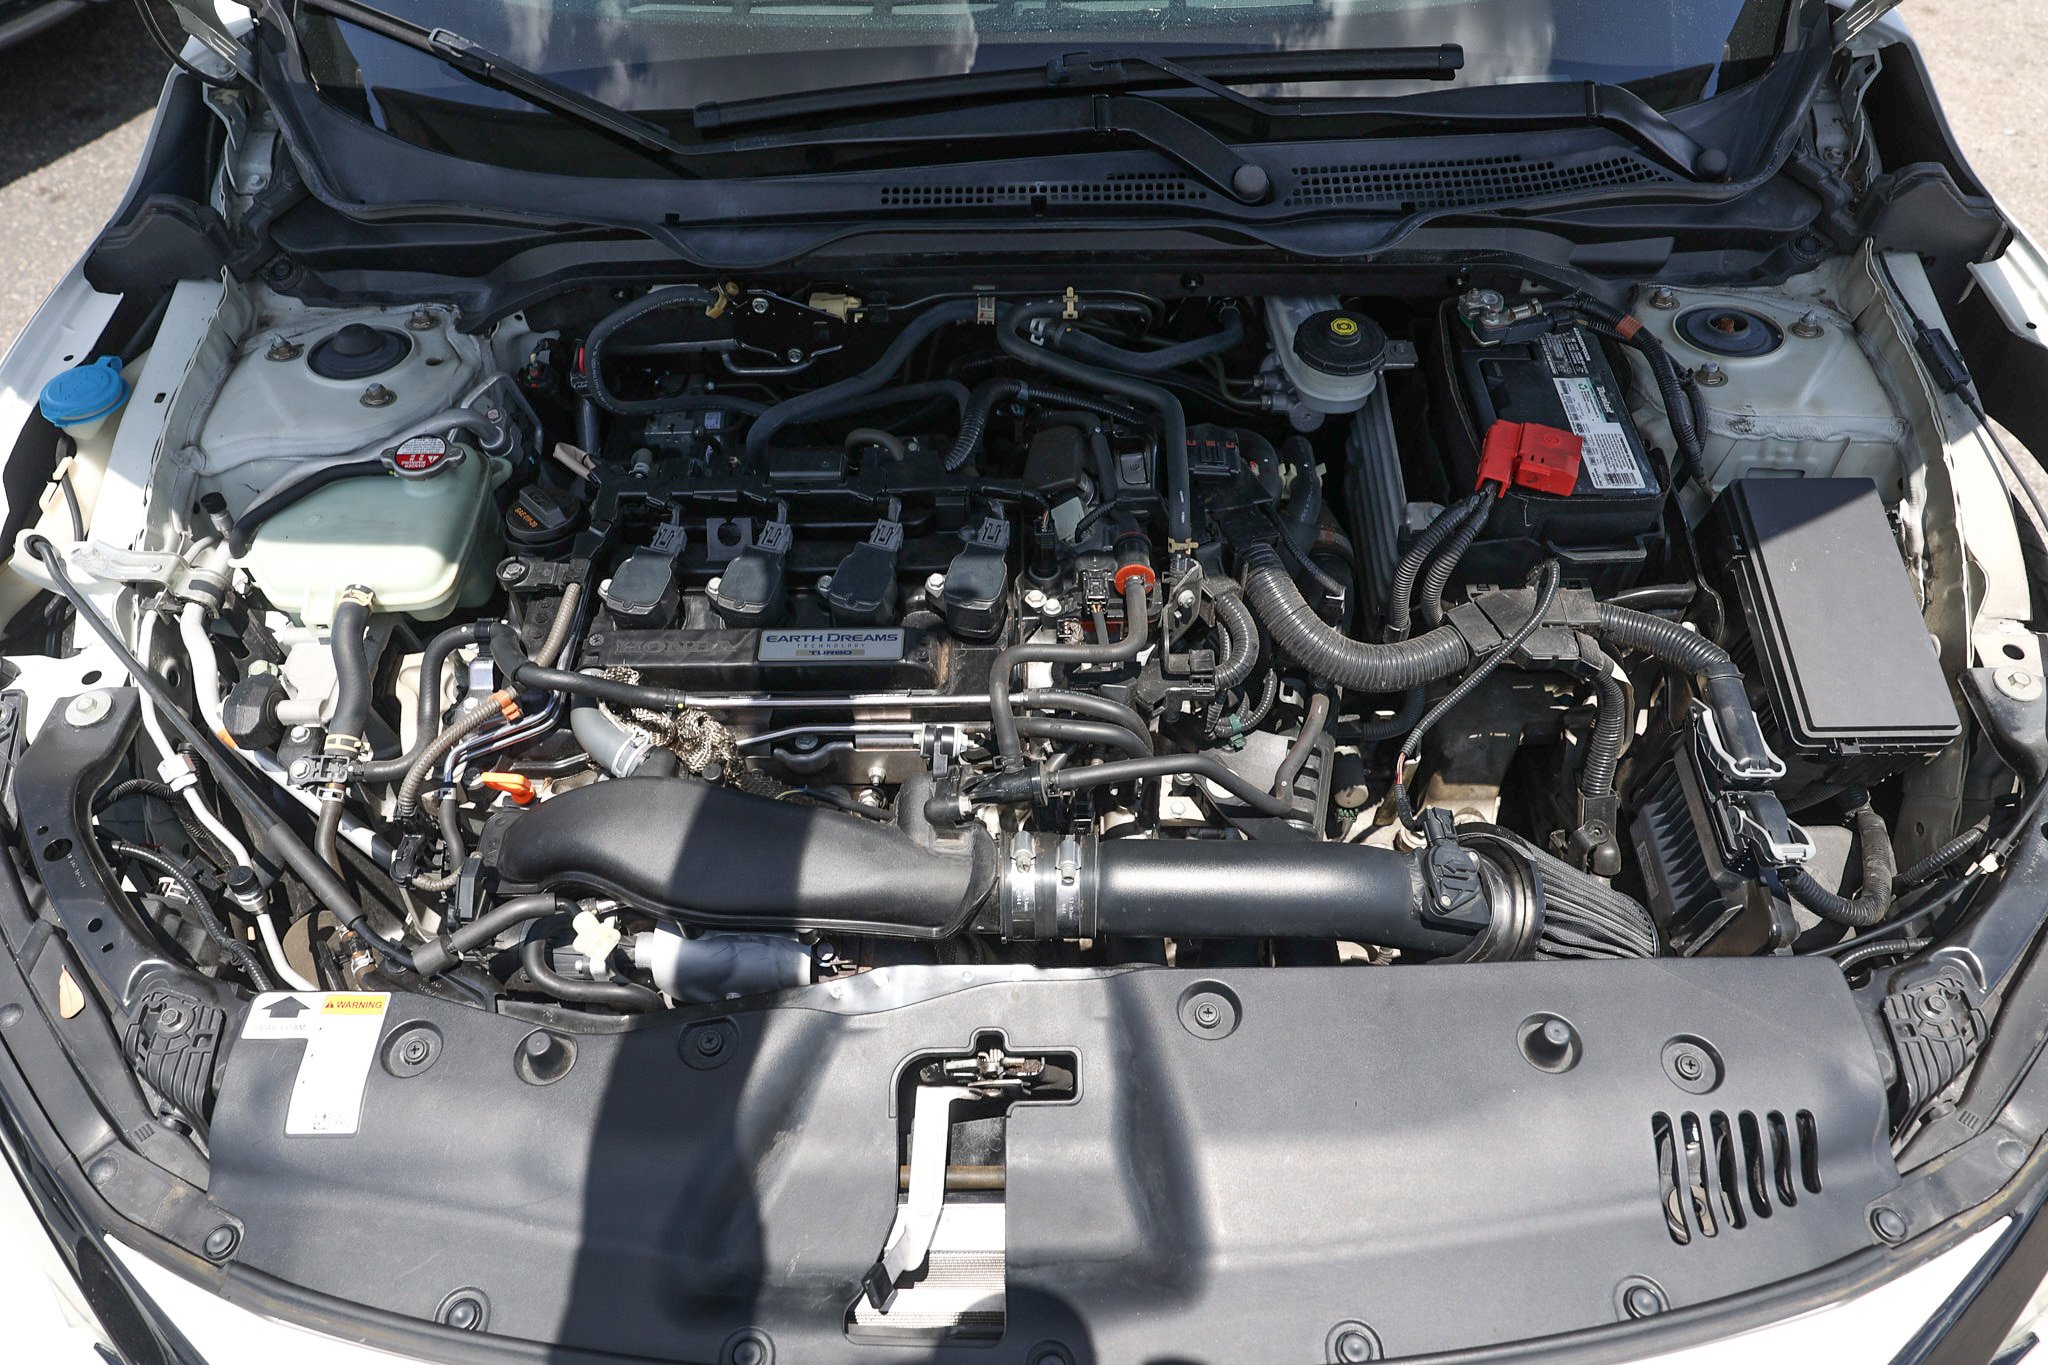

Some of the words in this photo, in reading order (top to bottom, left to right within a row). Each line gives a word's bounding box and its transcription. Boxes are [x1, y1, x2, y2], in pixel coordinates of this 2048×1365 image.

[1597, 385, 1614, 414] Duralast
[765, 634, 823, 643] EARTH
[827, 633, 899, 642] DREAMS
[615, 640, 737, 654] HONDA
[336, 1001, 383, 1009] WARNING
